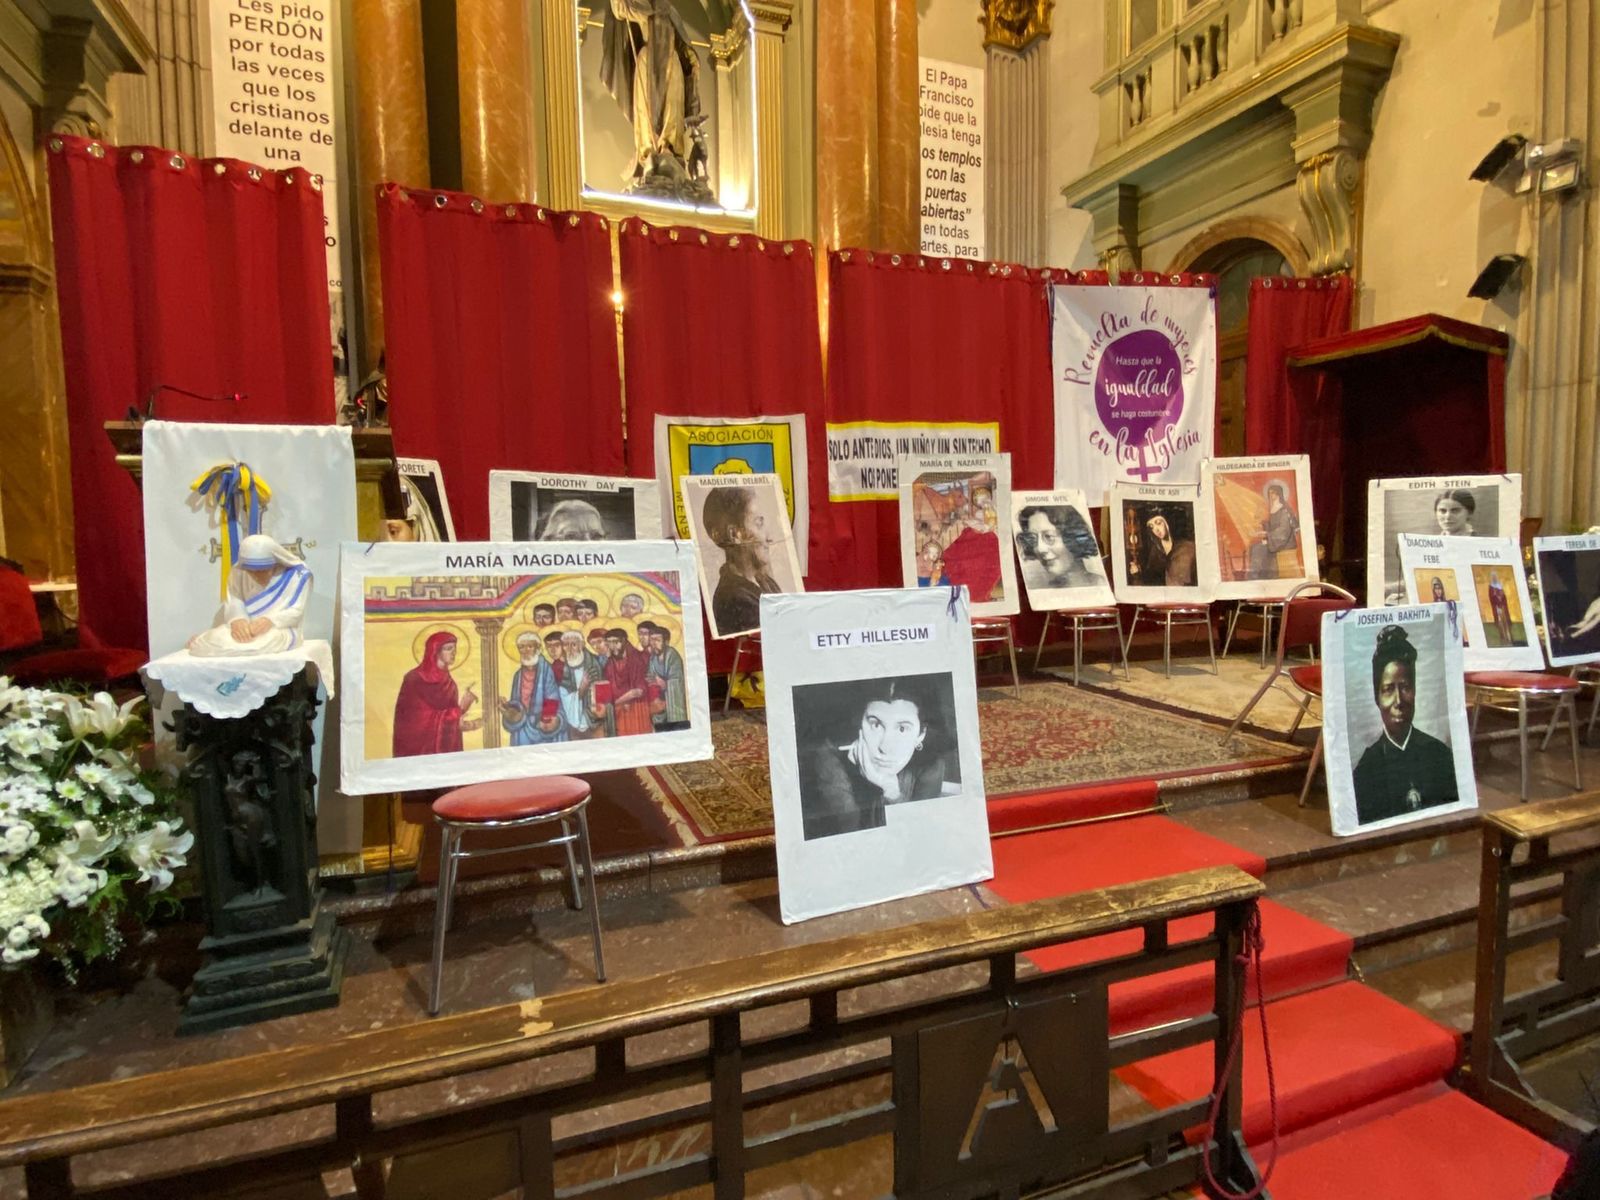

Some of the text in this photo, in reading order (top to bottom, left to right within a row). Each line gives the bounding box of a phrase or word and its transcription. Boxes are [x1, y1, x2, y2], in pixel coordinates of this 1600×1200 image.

[238, 0, 324, 21] Les pido
[229, 13, 322, 41] PERDÓN
[229, 38, 325, 62] por todas
[232, 56, 325, 83] las veces
[926, 68, 967, 90] El Papa
[242, 82, 316, 102] que los
[920, 85, 974, 108] Francisco
[230, 100, 330, 124] cristianos
[944, 111, 964, 125] que
[967, 112, 977, 126] la
[229, 120, 333, 145] delante de
[920, 122, 981, 146] lesia tenga
[264, 147, 301, 161] una
[922, 147, 982, 168] os templos
[926, 167, 966, 184] con las
[925, 187, 967, 203] puertas
[924, 224, 969, 239] en todas
[920, 240, 978, 258] artes, para
[1063, 311, 1130, 385] Revuelta
[1141, 295, 1157, 324] de
[1115, 356, 1139, 366] Hasta
[1141, 358, 1154, 366] que
[1105, 368, 1175, 408] igualdad
[1121, 410, 1136, 420] haga
[689, 429, 774, 442] ASOCIACIÓN
[828, 439, 850, 461] SOLO
[875, 438, 894, 464] DIOS,
[953, 438, 967, 454] SIN
[1144, 423, 1200, 469] Iglesia
[919, 459, 987, 468] MARÍA DE NAZARET
[541, 477, 616, 490] DOROTHY DAY
[699, 477, 737, 487] MADELEINE
[877, 468, 899, 489] PONE
[1408, 479, 1471, 489] EDITH STEIN
[1406, 538, 1443, 548] DIACONISA
[445, 552, 616, 568] MARÍA MAGDALENA
[1423, 554, 1441, 564] FEBE
[1479, 550, 1500, 559] TECLA
[1357, 609, 1430, 625] JOSEFINA BAKHITA
[817, 627, 929, 647] ETTY HILLESUM
